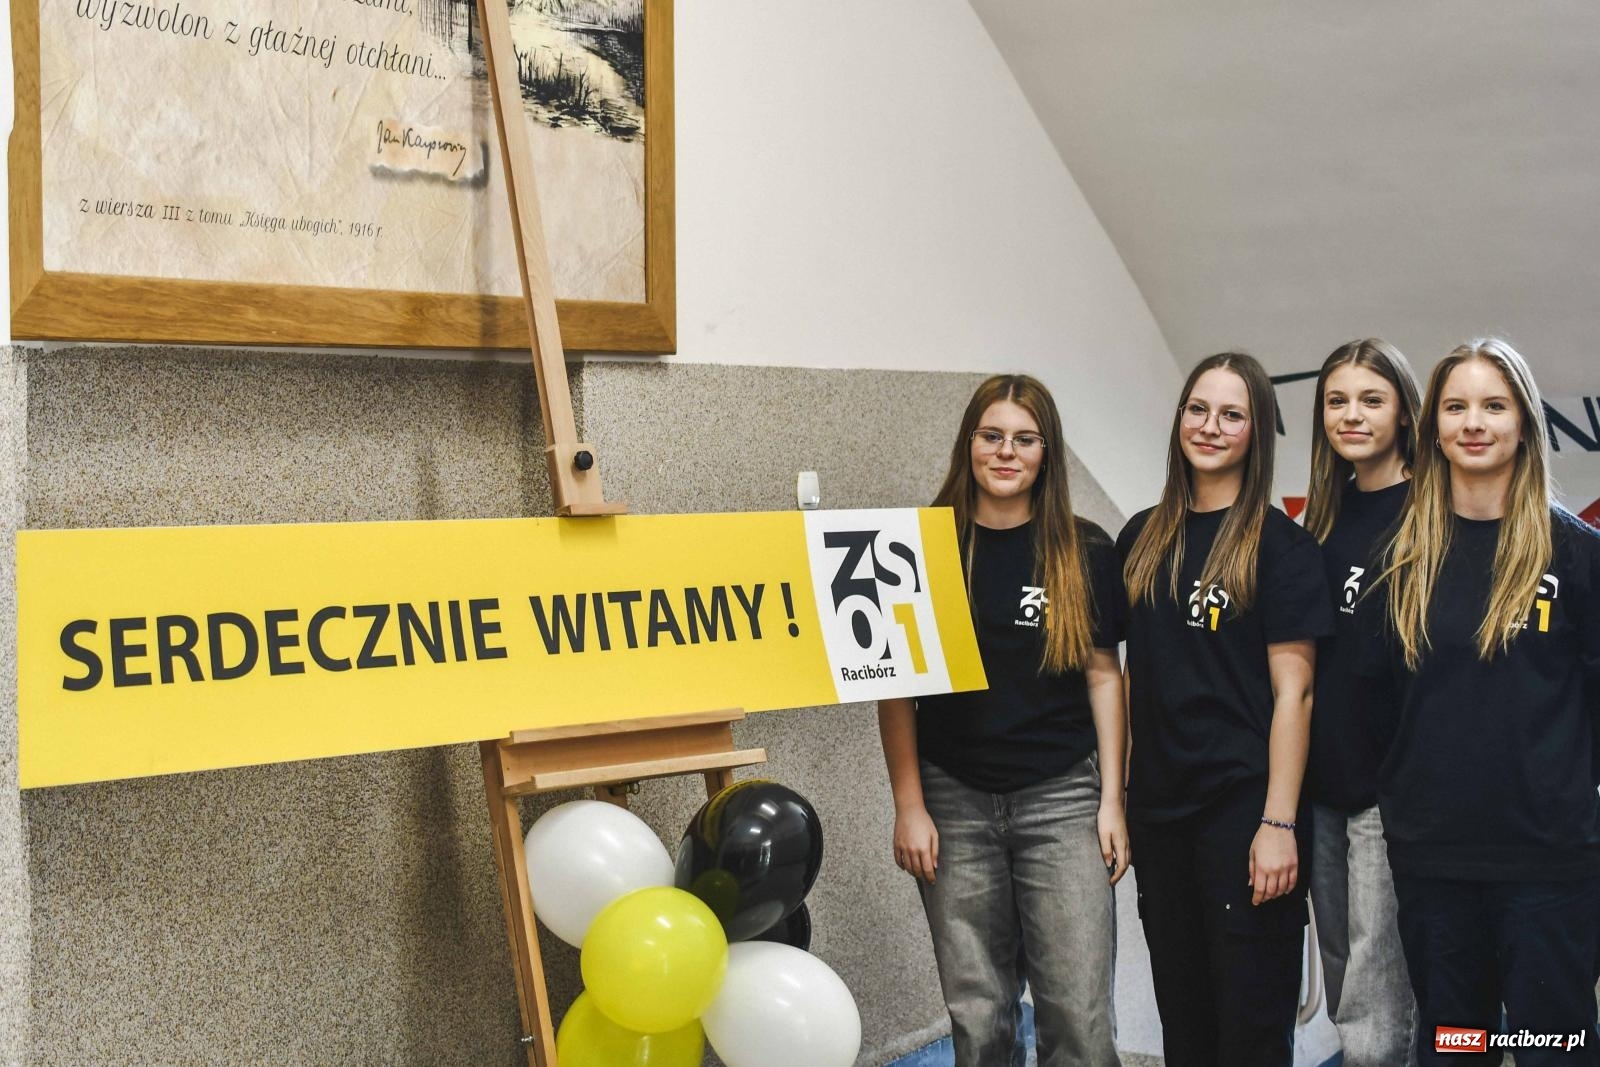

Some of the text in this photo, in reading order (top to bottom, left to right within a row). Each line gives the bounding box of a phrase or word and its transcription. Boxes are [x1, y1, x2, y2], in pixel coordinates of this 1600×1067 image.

[76, 0, 213, 40] wyzwolon
[224, 21, 241, 44] z
[346, 40, 446, 81] otchłani...
[79, 198, 90, 213] z
[95, 198, 155, 218] wiersza
[162, 205, 181, 221] III
[186, 209, 195, 222] z
[200, 208, 233, 226] tomu
[350, 222, 374, 238] 1916
[376, 226, 383, 239] r.
[60, 597, 508, 691] SERDECZNIE
[528, 584, 766, 655] WITAMY
[841, 664, 897, 682] Racibórz
